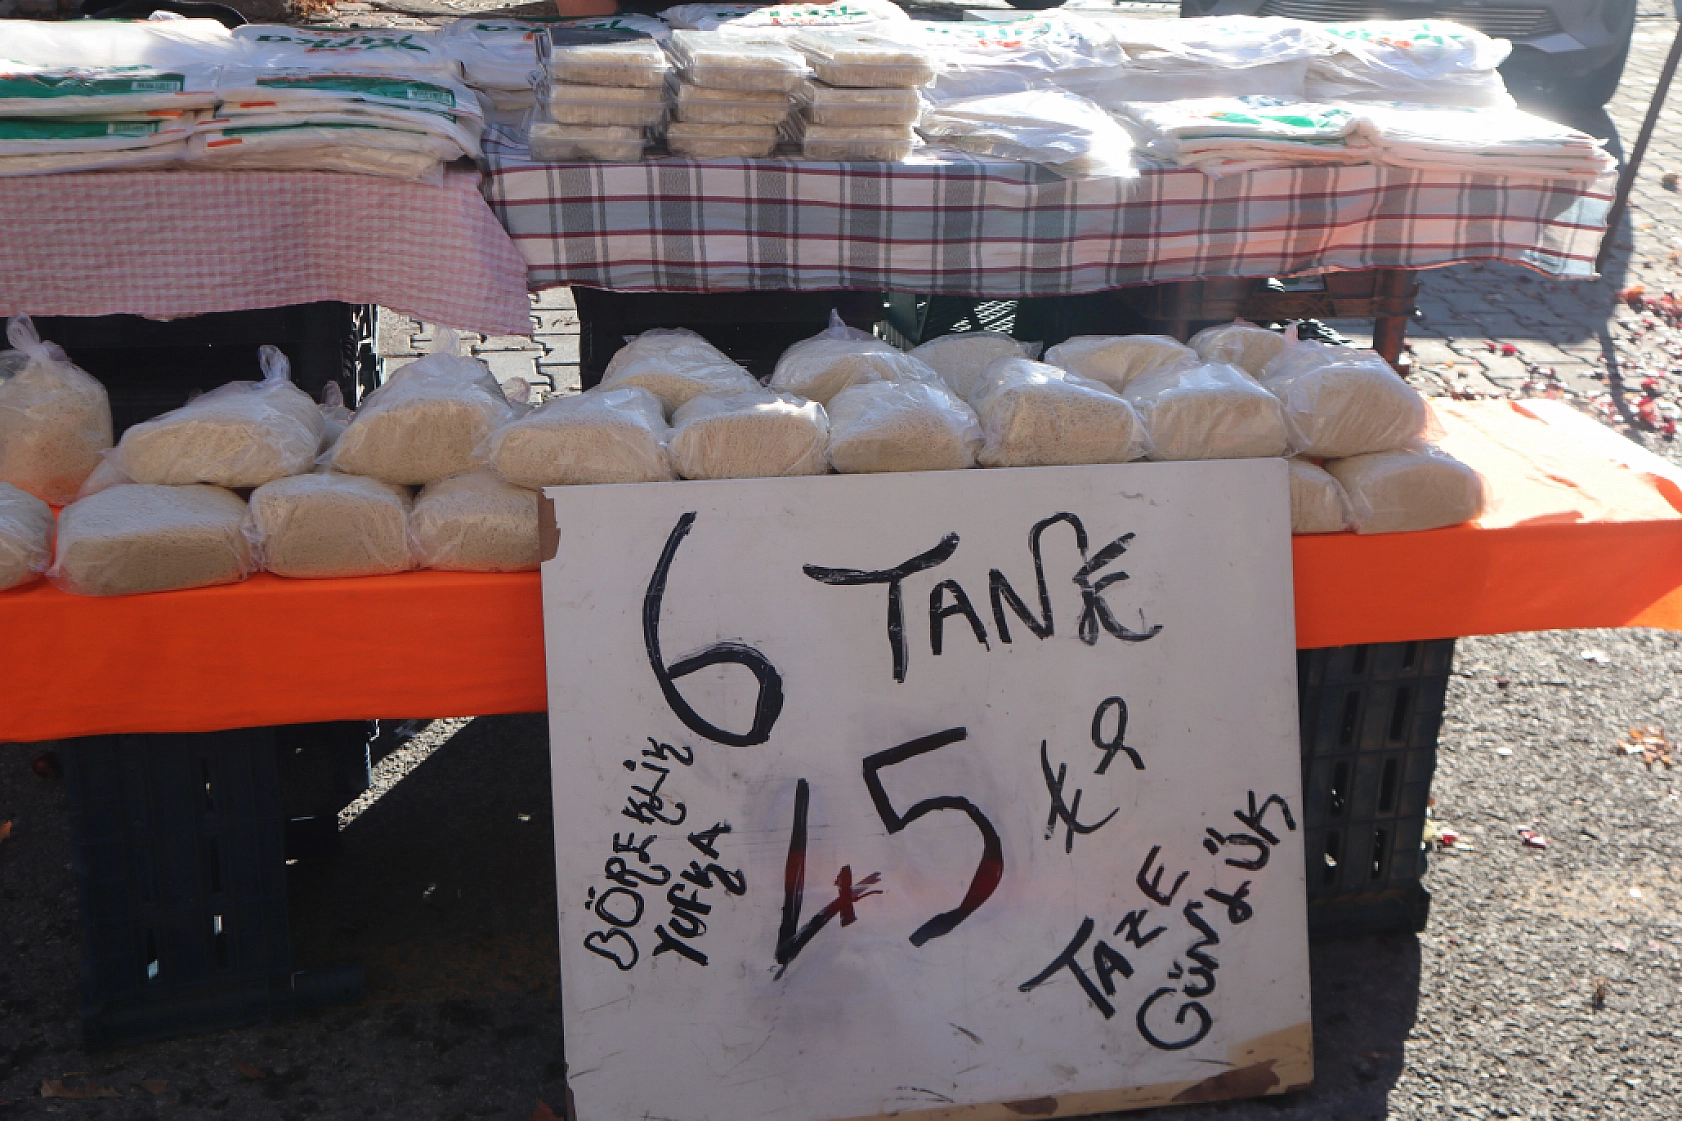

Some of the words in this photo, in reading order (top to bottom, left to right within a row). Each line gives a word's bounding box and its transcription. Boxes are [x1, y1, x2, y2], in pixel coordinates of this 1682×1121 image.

[642, 511, 784, 747] 6
[803, 511, 1163, 683] TANE
[652, 822, 747, 967] YUFKA
[773, 727, 1004, 982] 45
[1018, 845, 1190, 1020] TAZE
[1136, 791, 1297, 1052] GÜNLÜK
